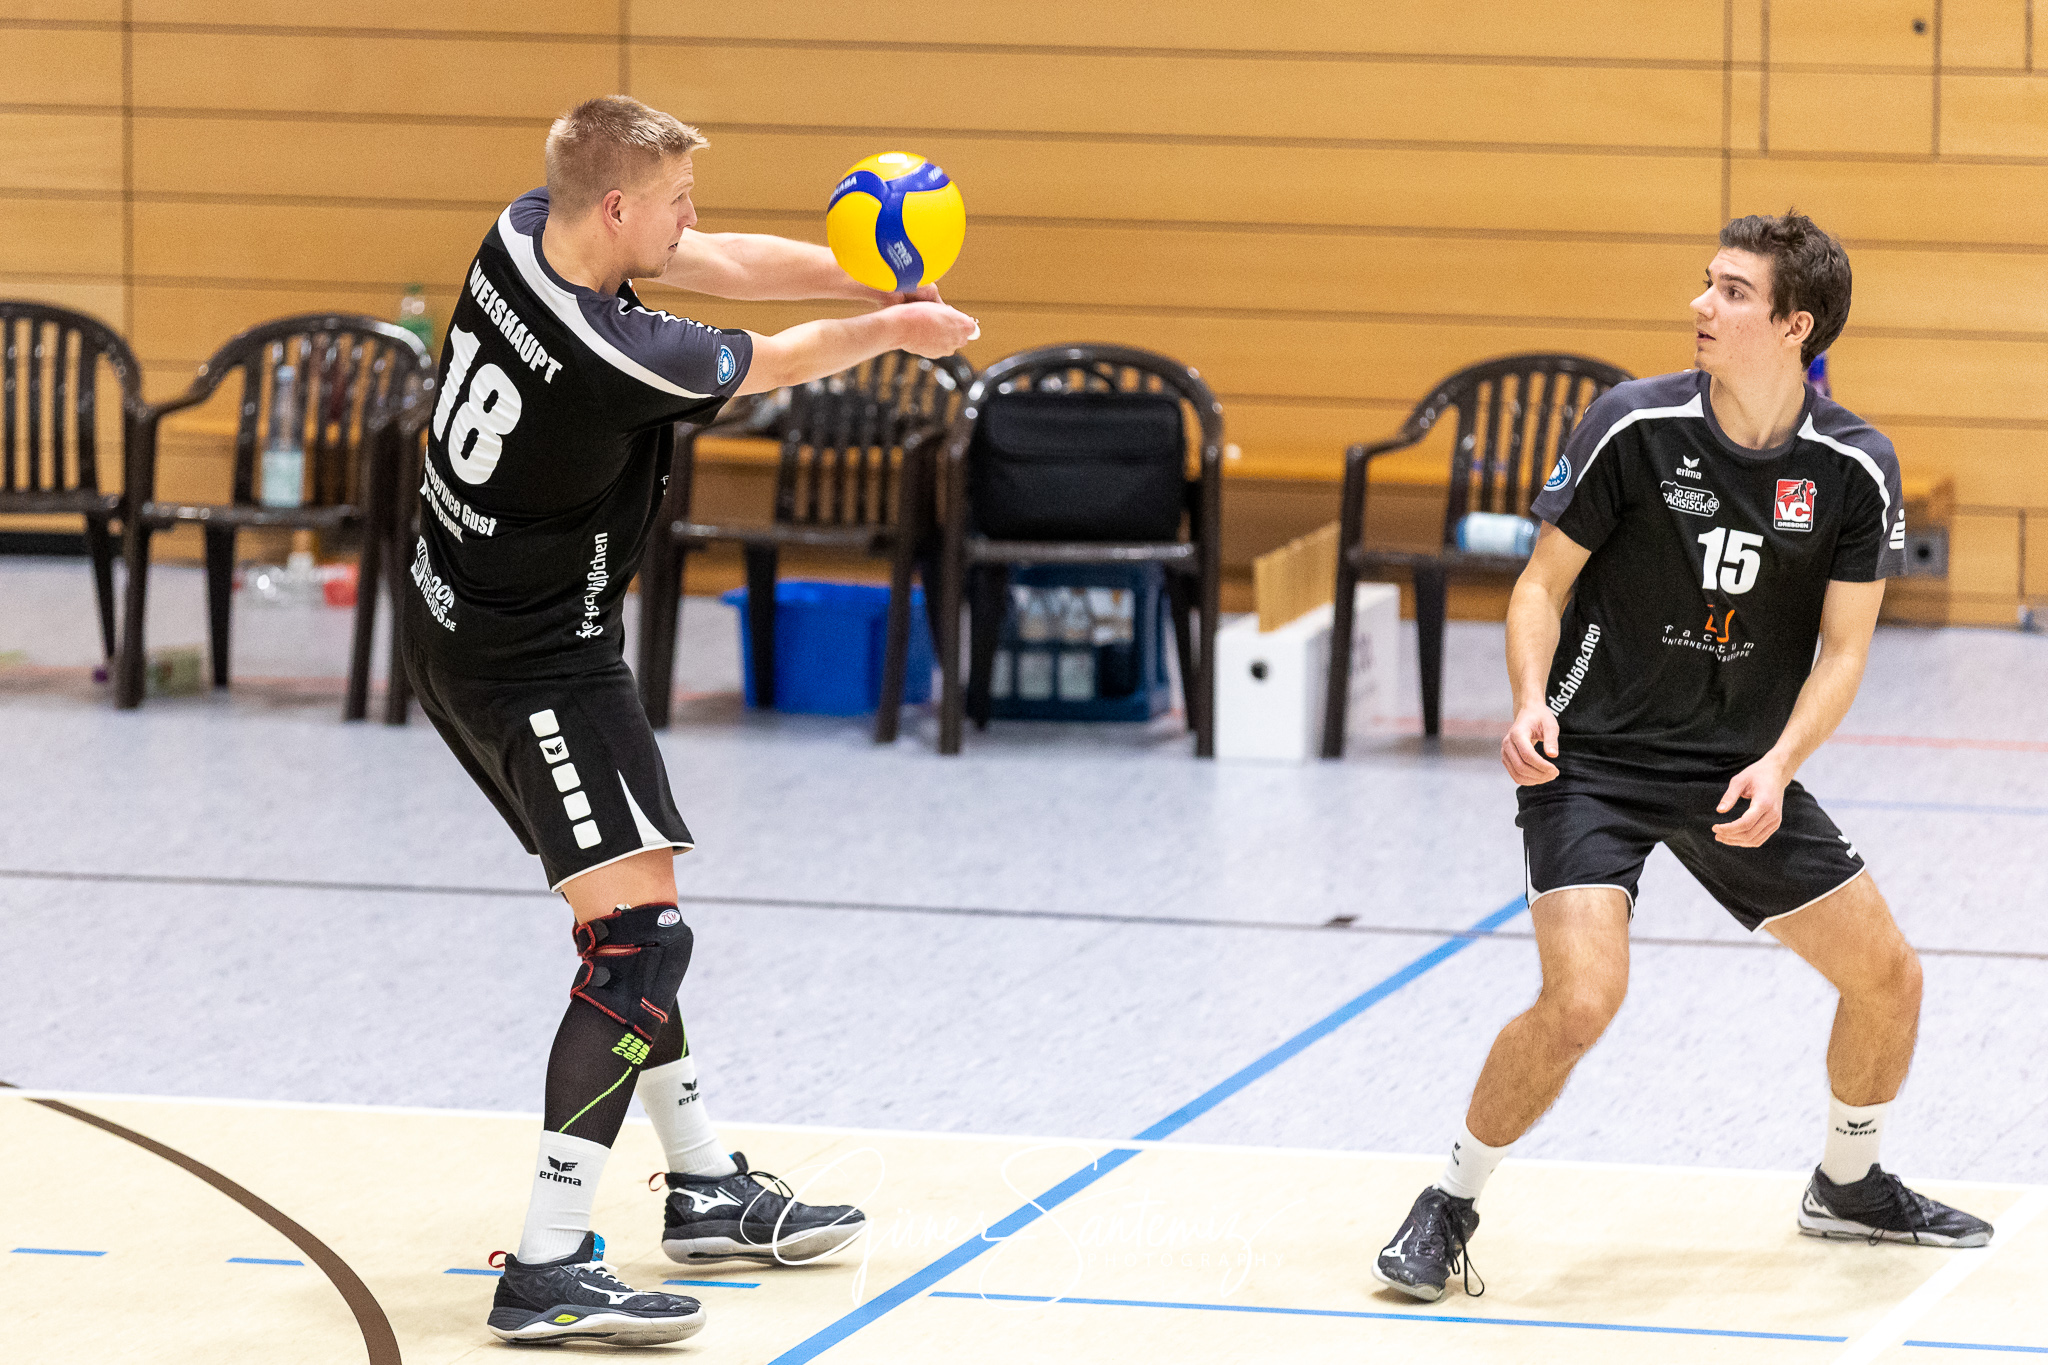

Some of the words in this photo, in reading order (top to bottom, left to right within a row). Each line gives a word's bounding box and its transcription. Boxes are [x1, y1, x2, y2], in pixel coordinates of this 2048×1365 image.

[470, 259, 563, 384] WEISHAUPT
[433, 324, 523, 485] 18
[1676, 467, 1702, 479] erima
[1674, 488, 1684, 498] SO
[1684, 491, 1705, 502] GEHT
[461, 504, 497, 537] Gust
[1777, 501, 1811, 522] VC
[1777, 521, 1809, 529] DRESDEN
[1697, 526, 1764, 595] 15
[539, 1170, 582, 1187] erima
